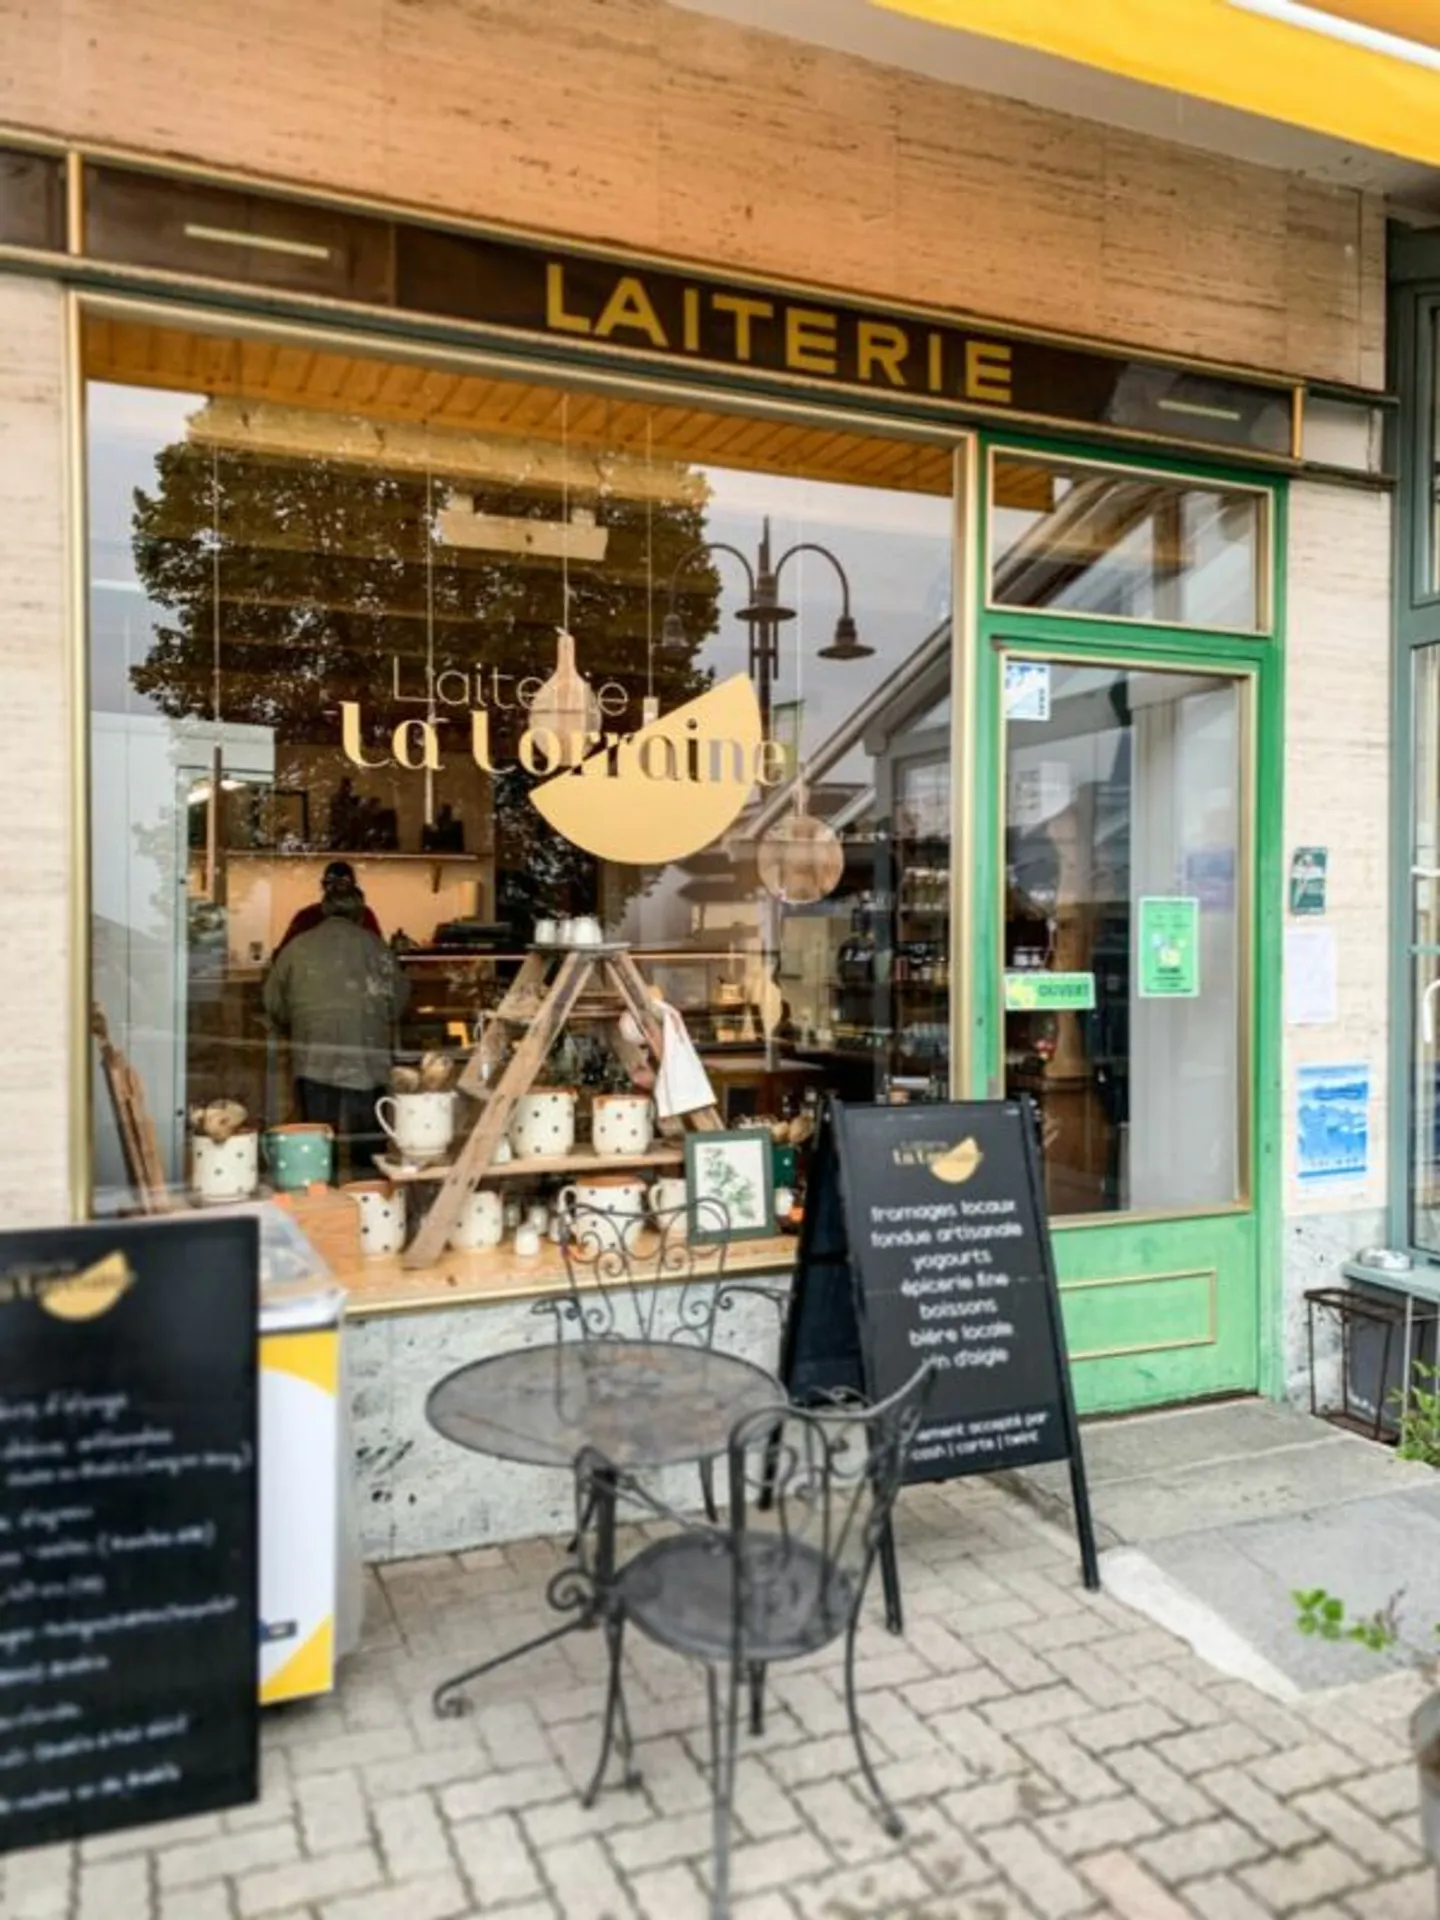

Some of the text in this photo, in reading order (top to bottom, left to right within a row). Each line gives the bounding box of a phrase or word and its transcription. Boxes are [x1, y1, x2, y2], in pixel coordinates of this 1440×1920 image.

[547, 264, 1011, 403] LAITERIE
[393, 656, 629, 716] Laitee
[871, 1199, 1016, 1223] fromages locaux
[870, 1222, 1023, 1248] fondue artisanale
[911, 1249, 993, 1274] yogourts
[901, 1271, 1010, 1298] épicerie fine
[919, 1298, 998, 1320] boissons
[961, 1321, 1014, 1341] locale
